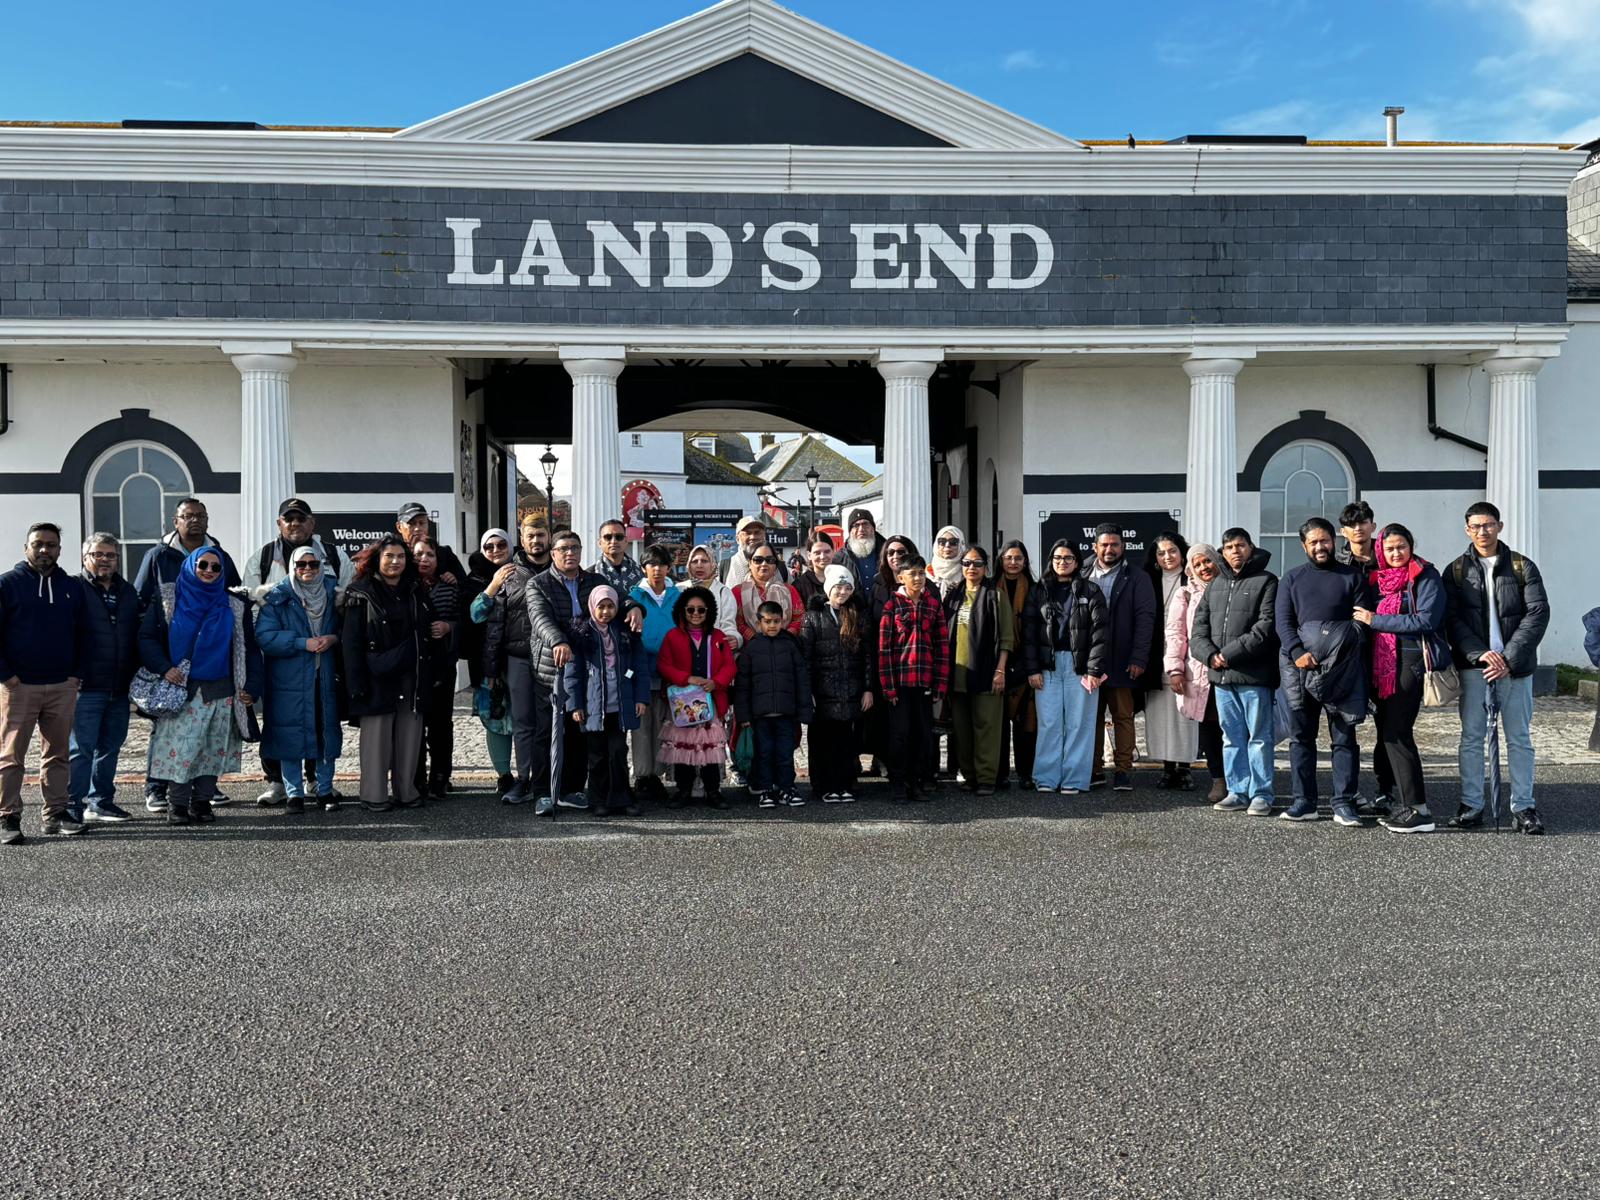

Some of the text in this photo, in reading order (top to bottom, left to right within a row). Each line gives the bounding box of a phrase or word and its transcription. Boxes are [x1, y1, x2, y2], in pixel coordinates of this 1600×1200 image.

[445, 217, 1054, 291] LAND'S END
[768, 534, 788, 544] Hut
[349, 543, 360, 552] to
[1079, 542, 1089, 551] to
[1125, 542, 1144, 551] End
